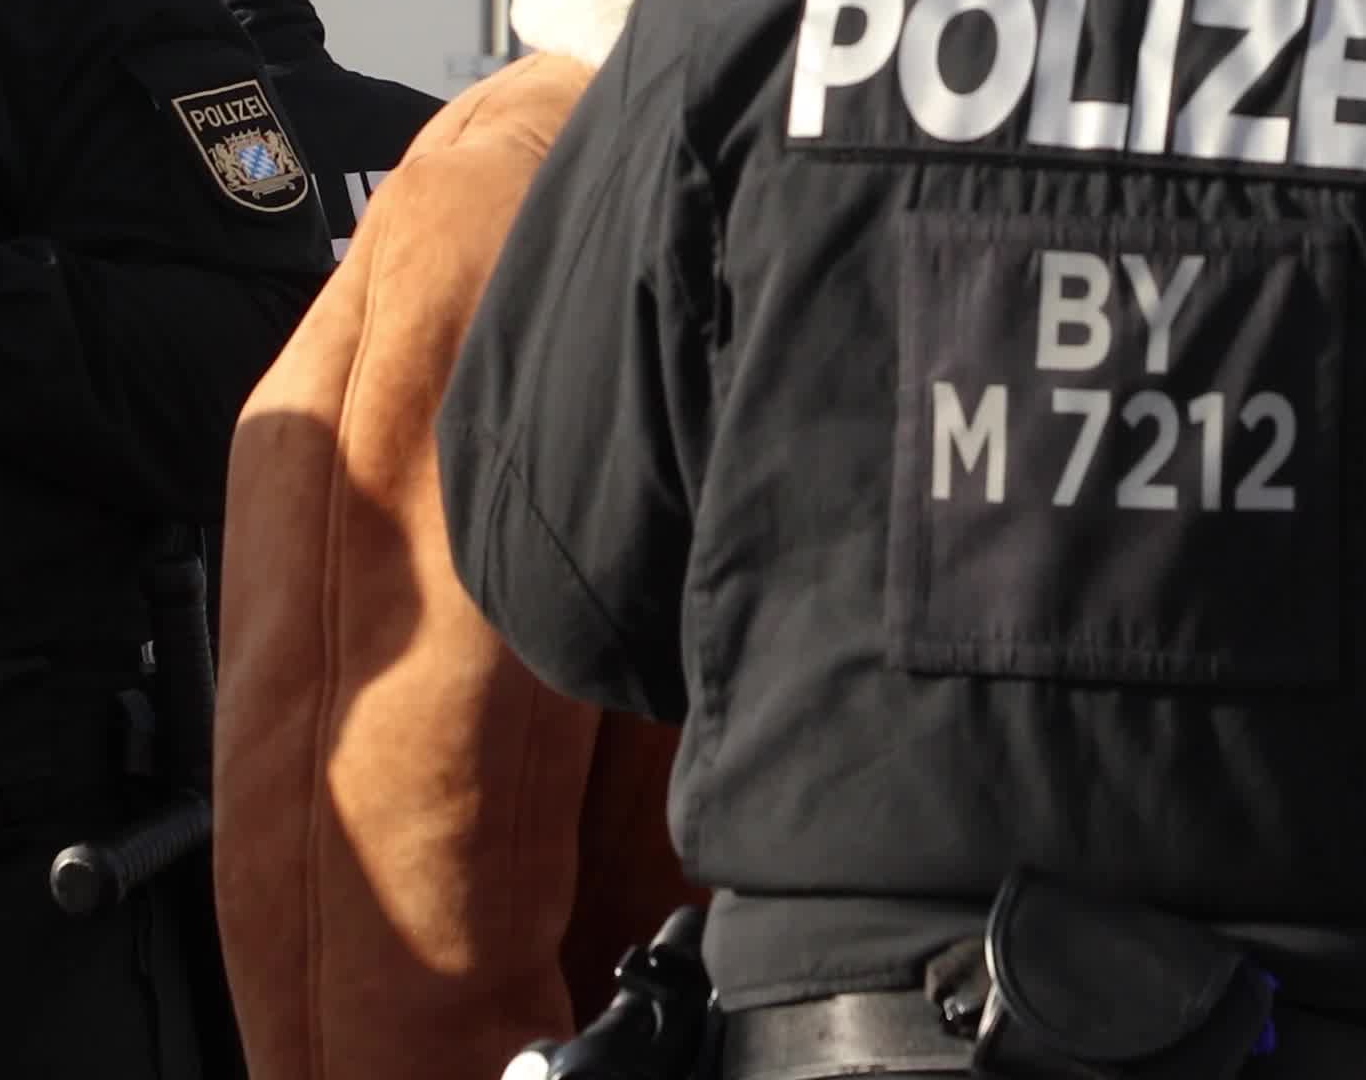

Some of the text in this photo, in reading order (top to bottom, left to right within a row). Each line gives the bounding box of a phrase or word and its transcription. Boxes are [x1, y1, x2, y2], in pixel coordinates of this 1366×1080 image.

[190, 96, 267, 131] POLIZEI
[1037, 251, 1205, 374] BY
[931, 381, 1297, 511] M 7212
